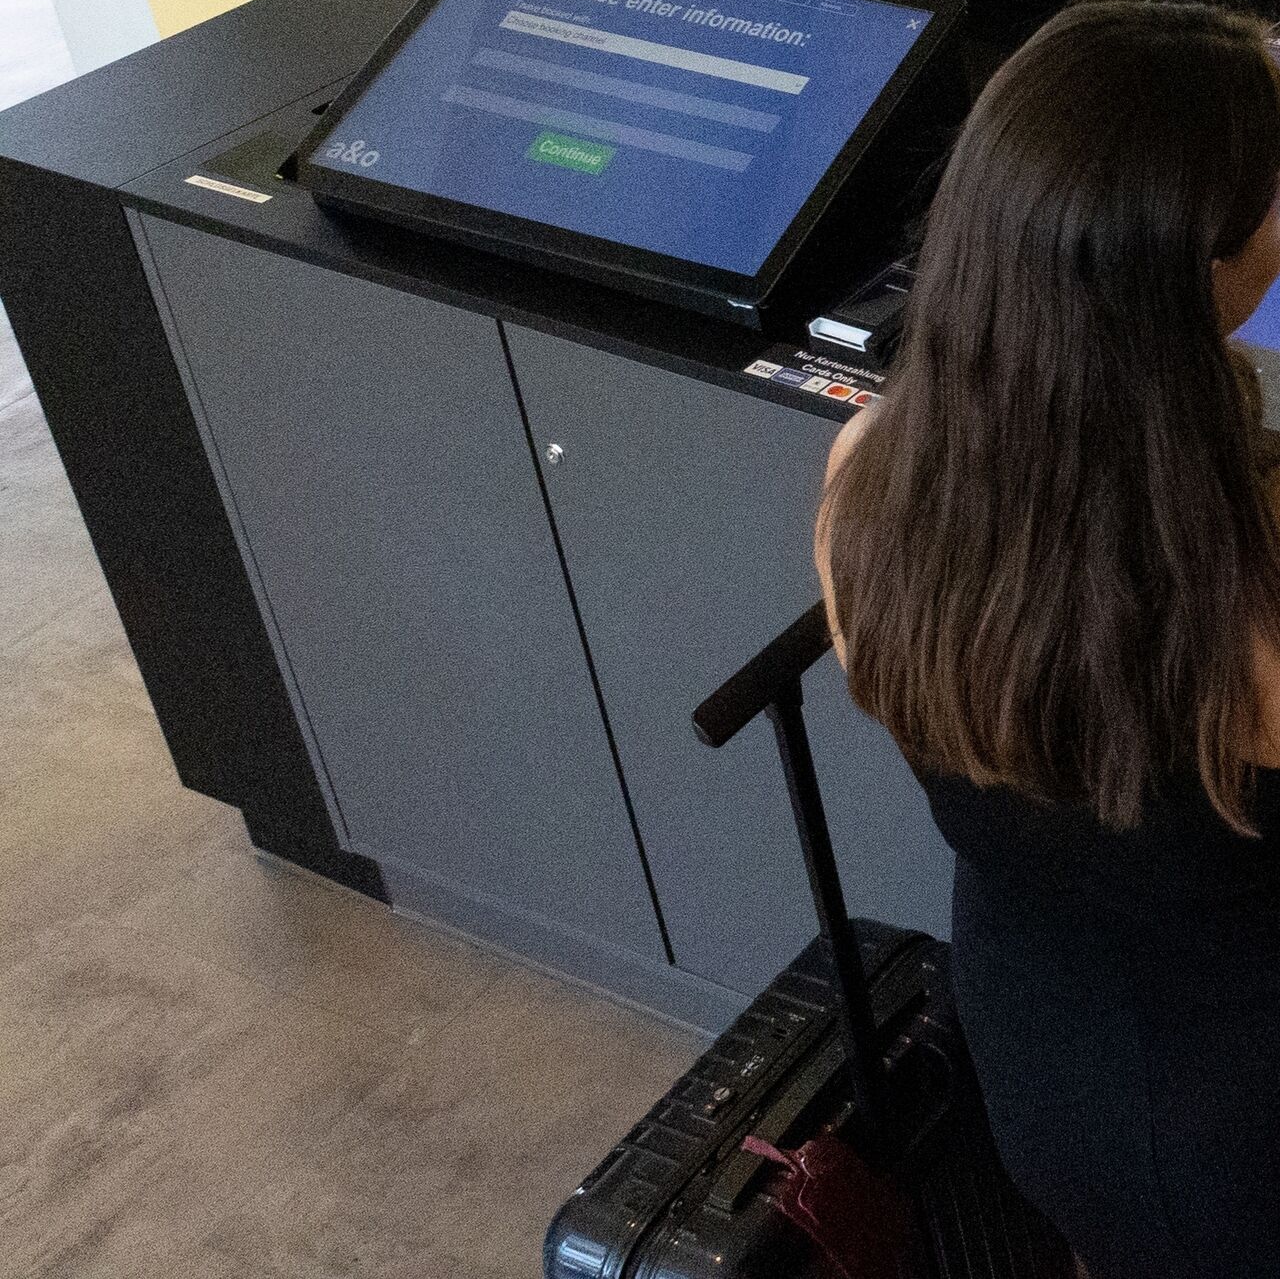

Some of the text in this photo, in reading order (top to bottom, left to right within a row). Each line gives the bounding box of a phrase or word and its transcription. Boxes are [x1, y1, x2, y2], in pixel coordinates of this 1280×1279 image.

[682, 4, 811, 47] information:
[325, 140, 381, 168] a&o
[540, 140, 601, 164] Continue
[753, 363, 777, 375] VISA
[794, 350, 815, 361] Nur
[815, 356, 886, 383] Kartenzahlung
[802, 363, 833, 379] Cards
[832, 372, 858, 385] Only
